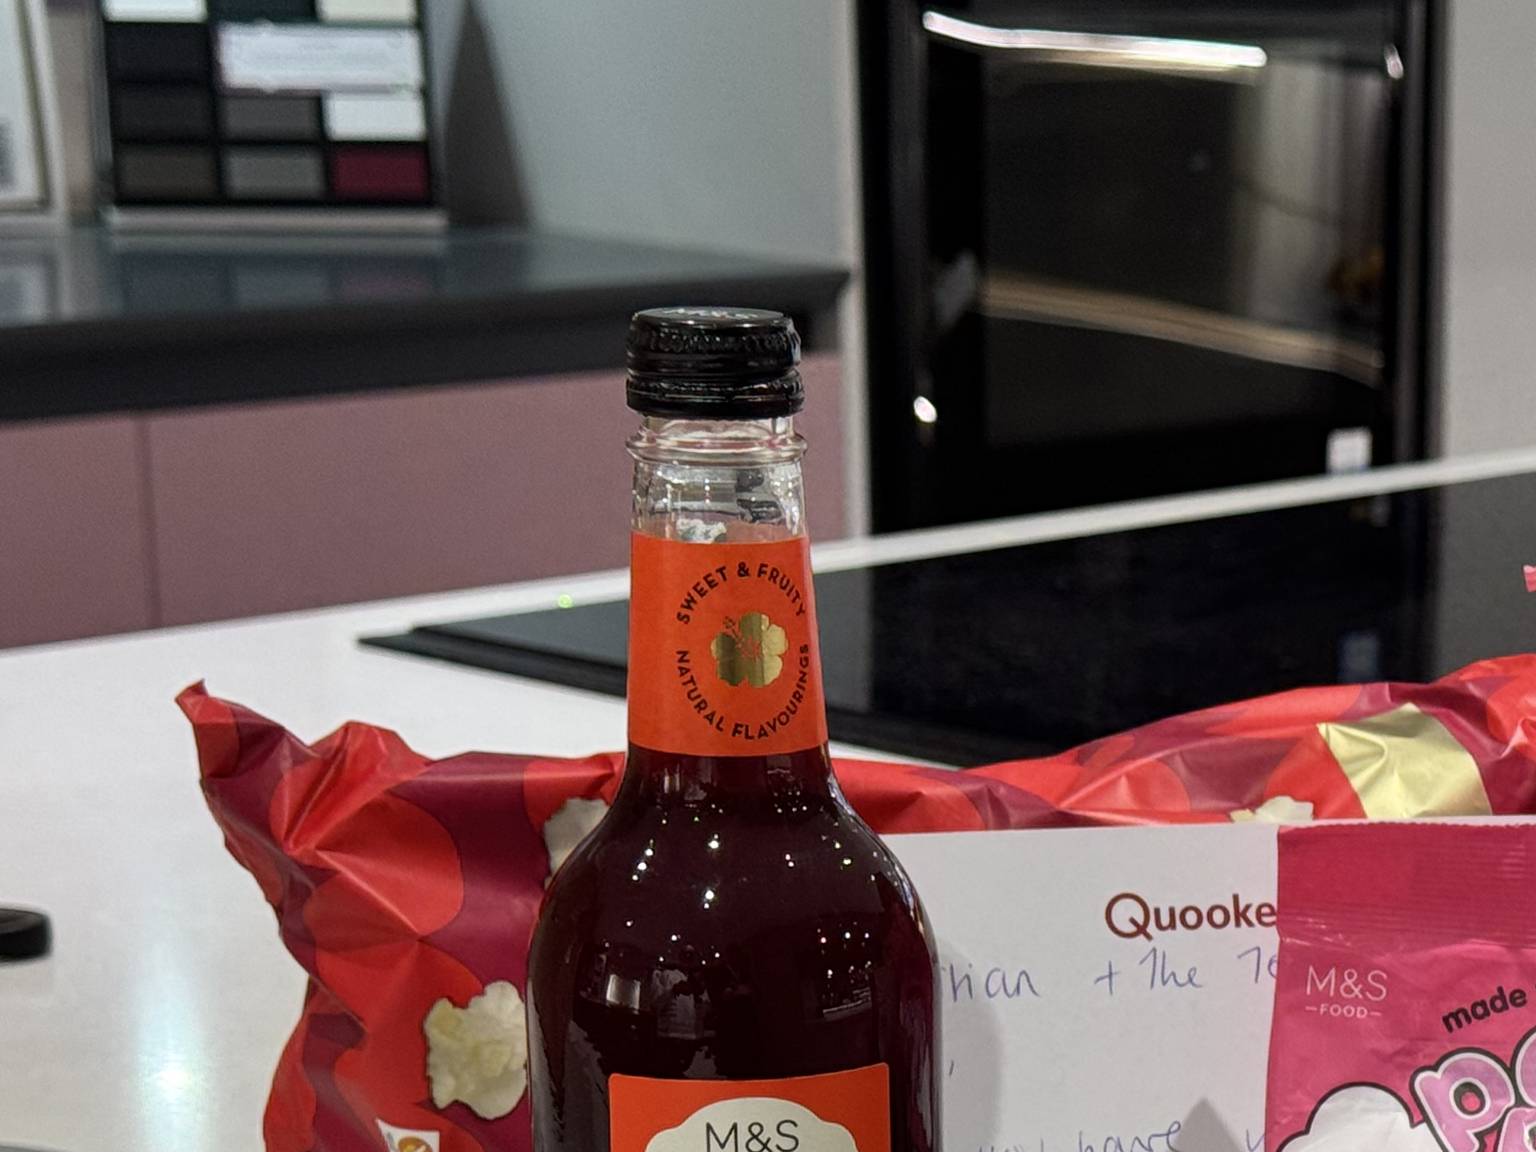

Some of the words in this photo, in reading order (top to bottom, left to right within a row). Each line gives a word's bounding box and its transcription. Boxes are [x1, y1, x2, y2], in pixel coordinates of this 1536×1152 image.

[676, 565, 728, 624] SWEET
[737, 561, 751, 577] &
[757, 563, 806, 617] FRUITY
[675, 650, 724, 732] NATURAL
[731, 644, 809, 740] FLAVOURINGS
[1105, 892, 1277, 941] Quooke
[1305, 966, 1388, 1001] M&S
[1320, 1004, 1369, 1018] FOOD
[1442, 985, 1528, 1034] made
